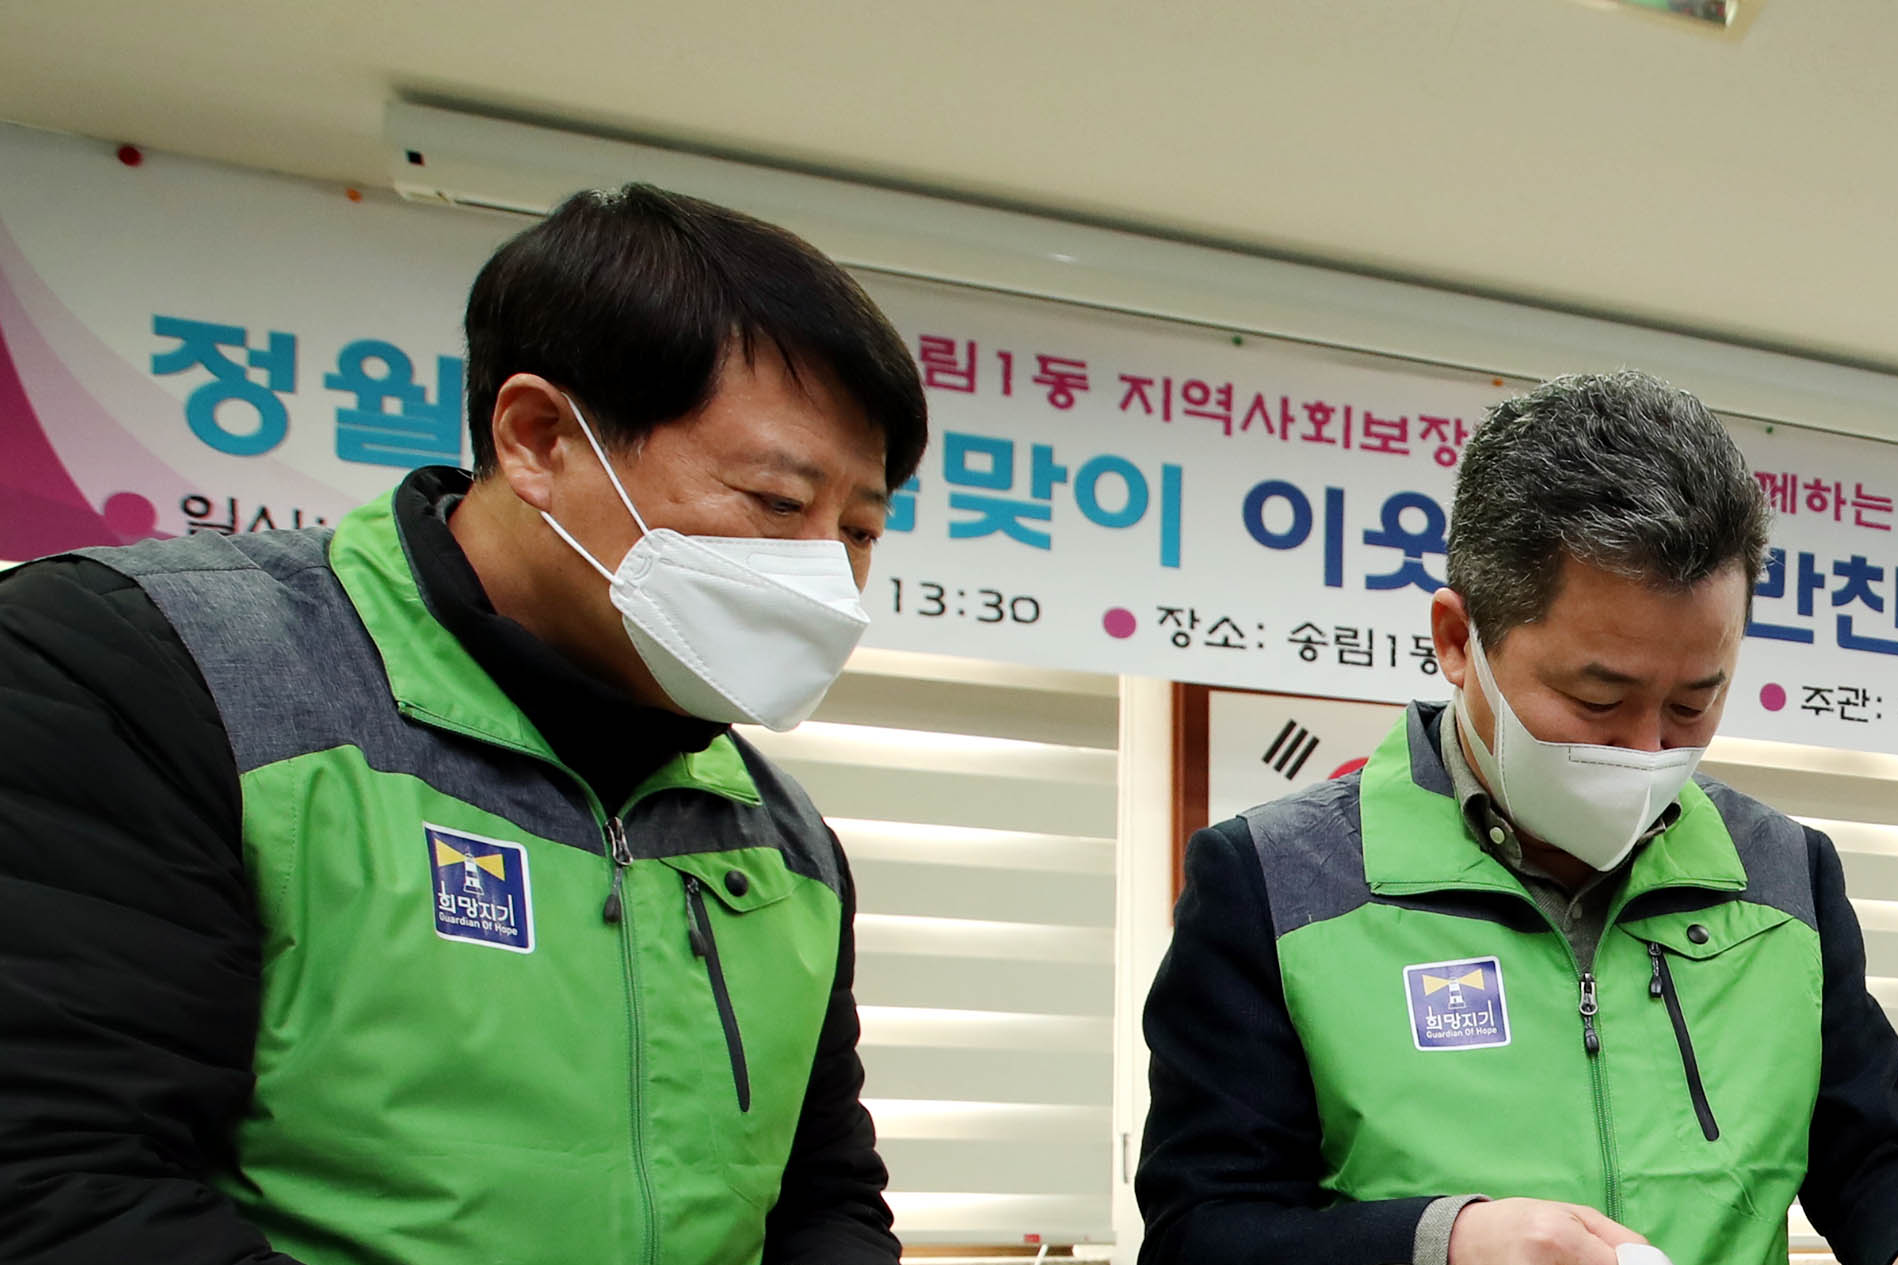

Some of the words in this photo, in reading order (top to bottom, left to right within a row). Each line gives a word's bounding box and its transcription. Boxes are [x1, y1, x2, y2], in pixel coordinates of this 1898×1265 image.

[1118, 373, 1468, 467] 지역사회보장
[885, 430, 1183, 570] 맞이
[1242, 478, 1449, 597] 이웃
[889, 576, 1041, 625] 13:30
[1156, 605, 1265, 649] 장소:
[1800, 685, 1883, 723] 주관:
[437, 880, 515, 926] 희망지기
[438, 911, 480, 929] Guardian
[482, 920, 493, 931] Of
[494, 922, 518, 936] Hope
[1425, 999, 1495, 1030] 희망지기
[1426, 1027, 1463, 1039] Guardian
[1464, 1027, 1474, 1036] Of
[1476, 1026, 1498, 1036] Hope
